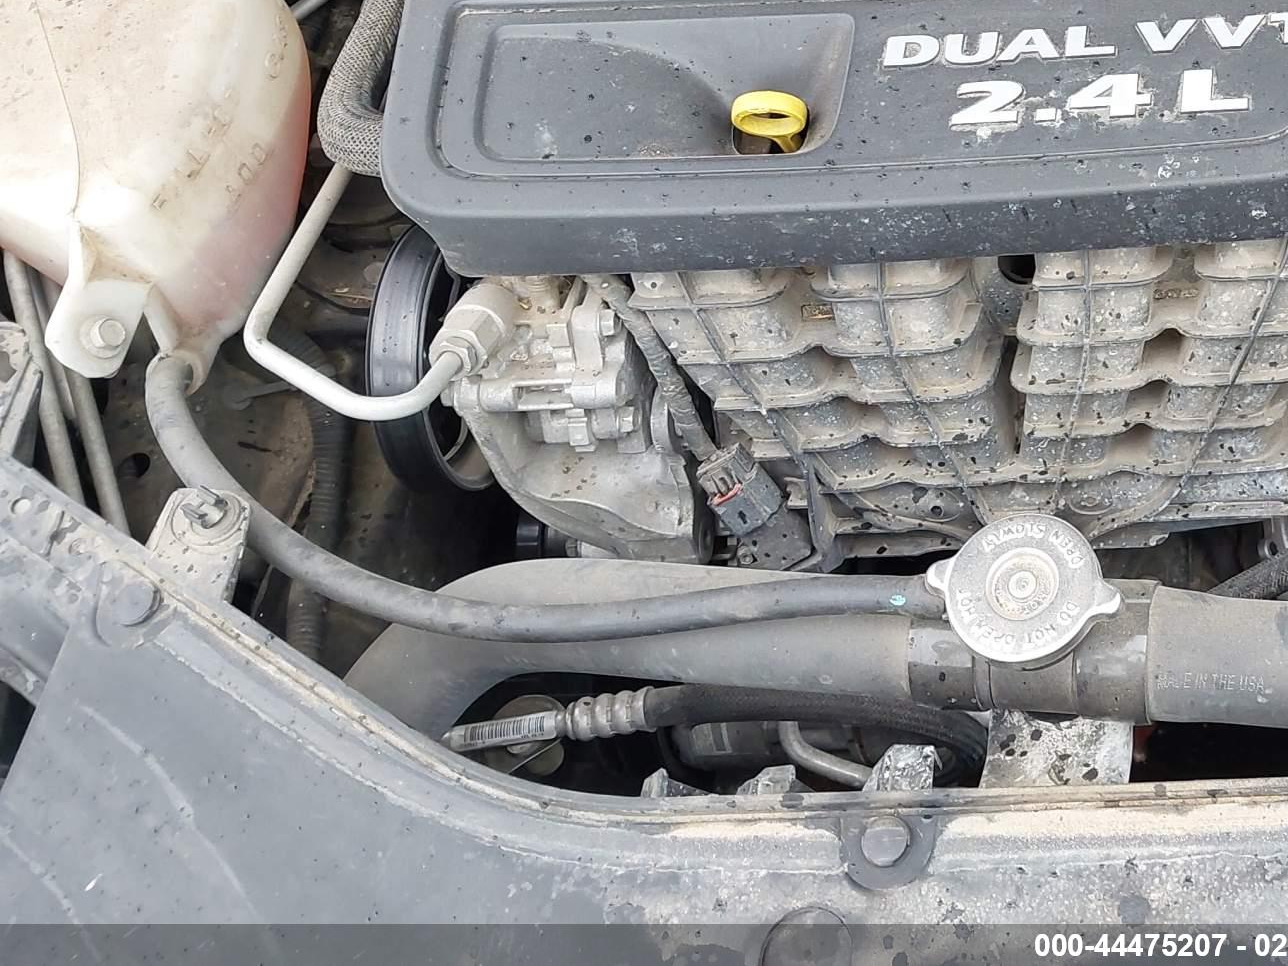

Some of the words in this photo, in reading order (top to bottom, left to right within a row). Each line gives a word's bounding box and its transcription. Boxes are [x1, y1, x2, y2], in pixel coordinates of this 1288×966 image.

[882, 24, 1119, 68] DUAL
[1048, 529, 1085, 569] OPEN
[1057, 600, 1081, 626] DO
[1024, 622, 1059, 645] NOT
[1211, 673, 1236, 691] THE
[1238, 674, 1265, 693] USA
